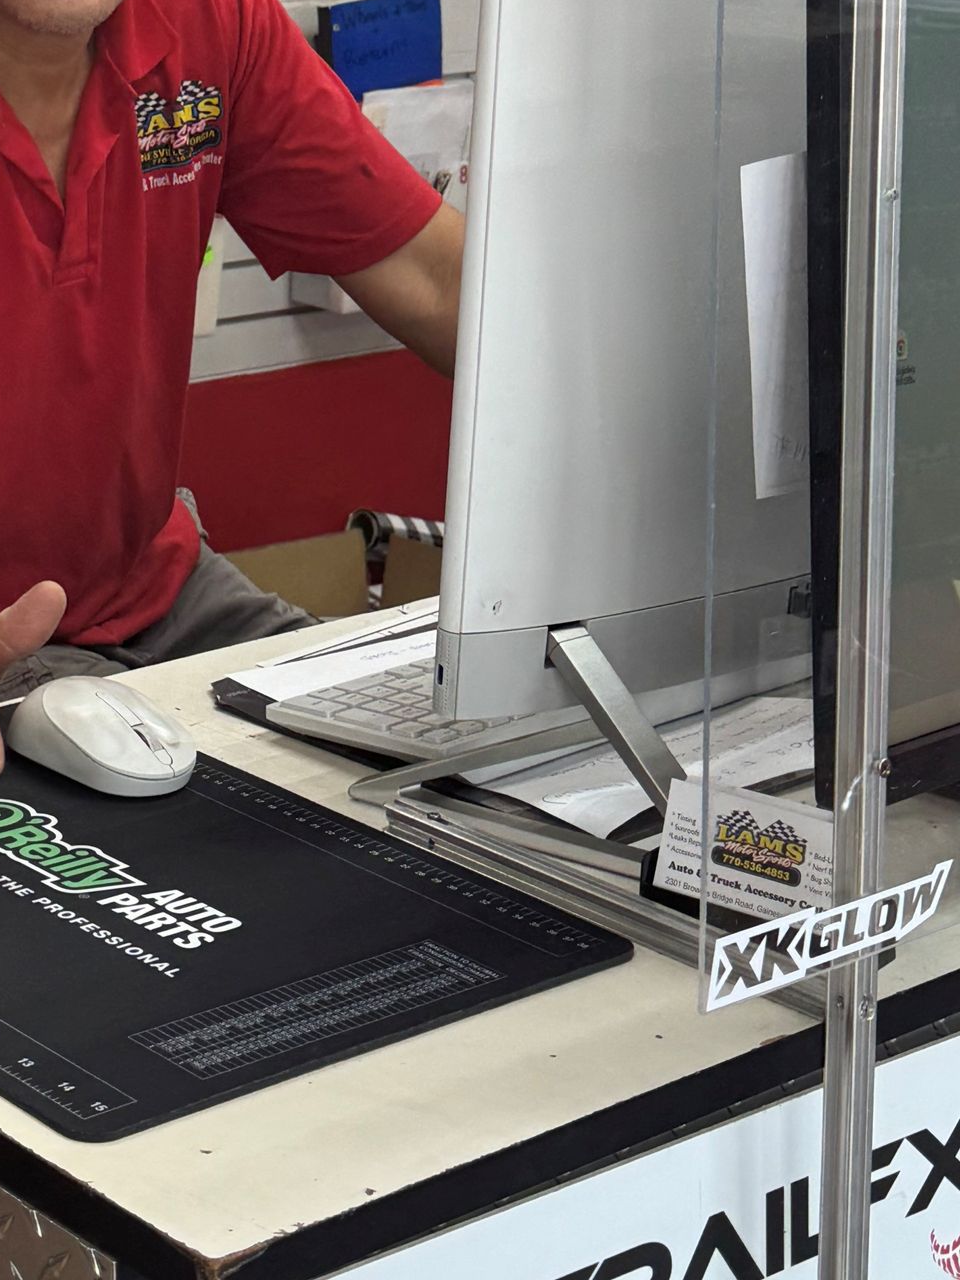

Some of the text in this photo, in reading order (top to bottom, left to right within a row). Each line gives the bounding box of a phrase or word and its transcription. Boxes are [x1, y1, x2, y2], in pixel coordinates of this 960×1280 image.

[716, 823, 806, 866] LAMS
[722, 852, 790, 882] 770-536-4853
[664, 876, 682, 888] 2301
[711, 890, 734, 904] Bridge
[668, 860, 797, 908] Auto Truck Accessory
[96, 892, 215, 950] PARTS
[141, 888, 243, 934] AUTO
[32, 896, 181, 978] PROFESSIONAL
[712, 866, 946, 1005] XKGLOW
[17, 1057, 35, 1069] 13
[58, 1081, 76, 1093] 14
[90, 1100, 109, 1114] 15
